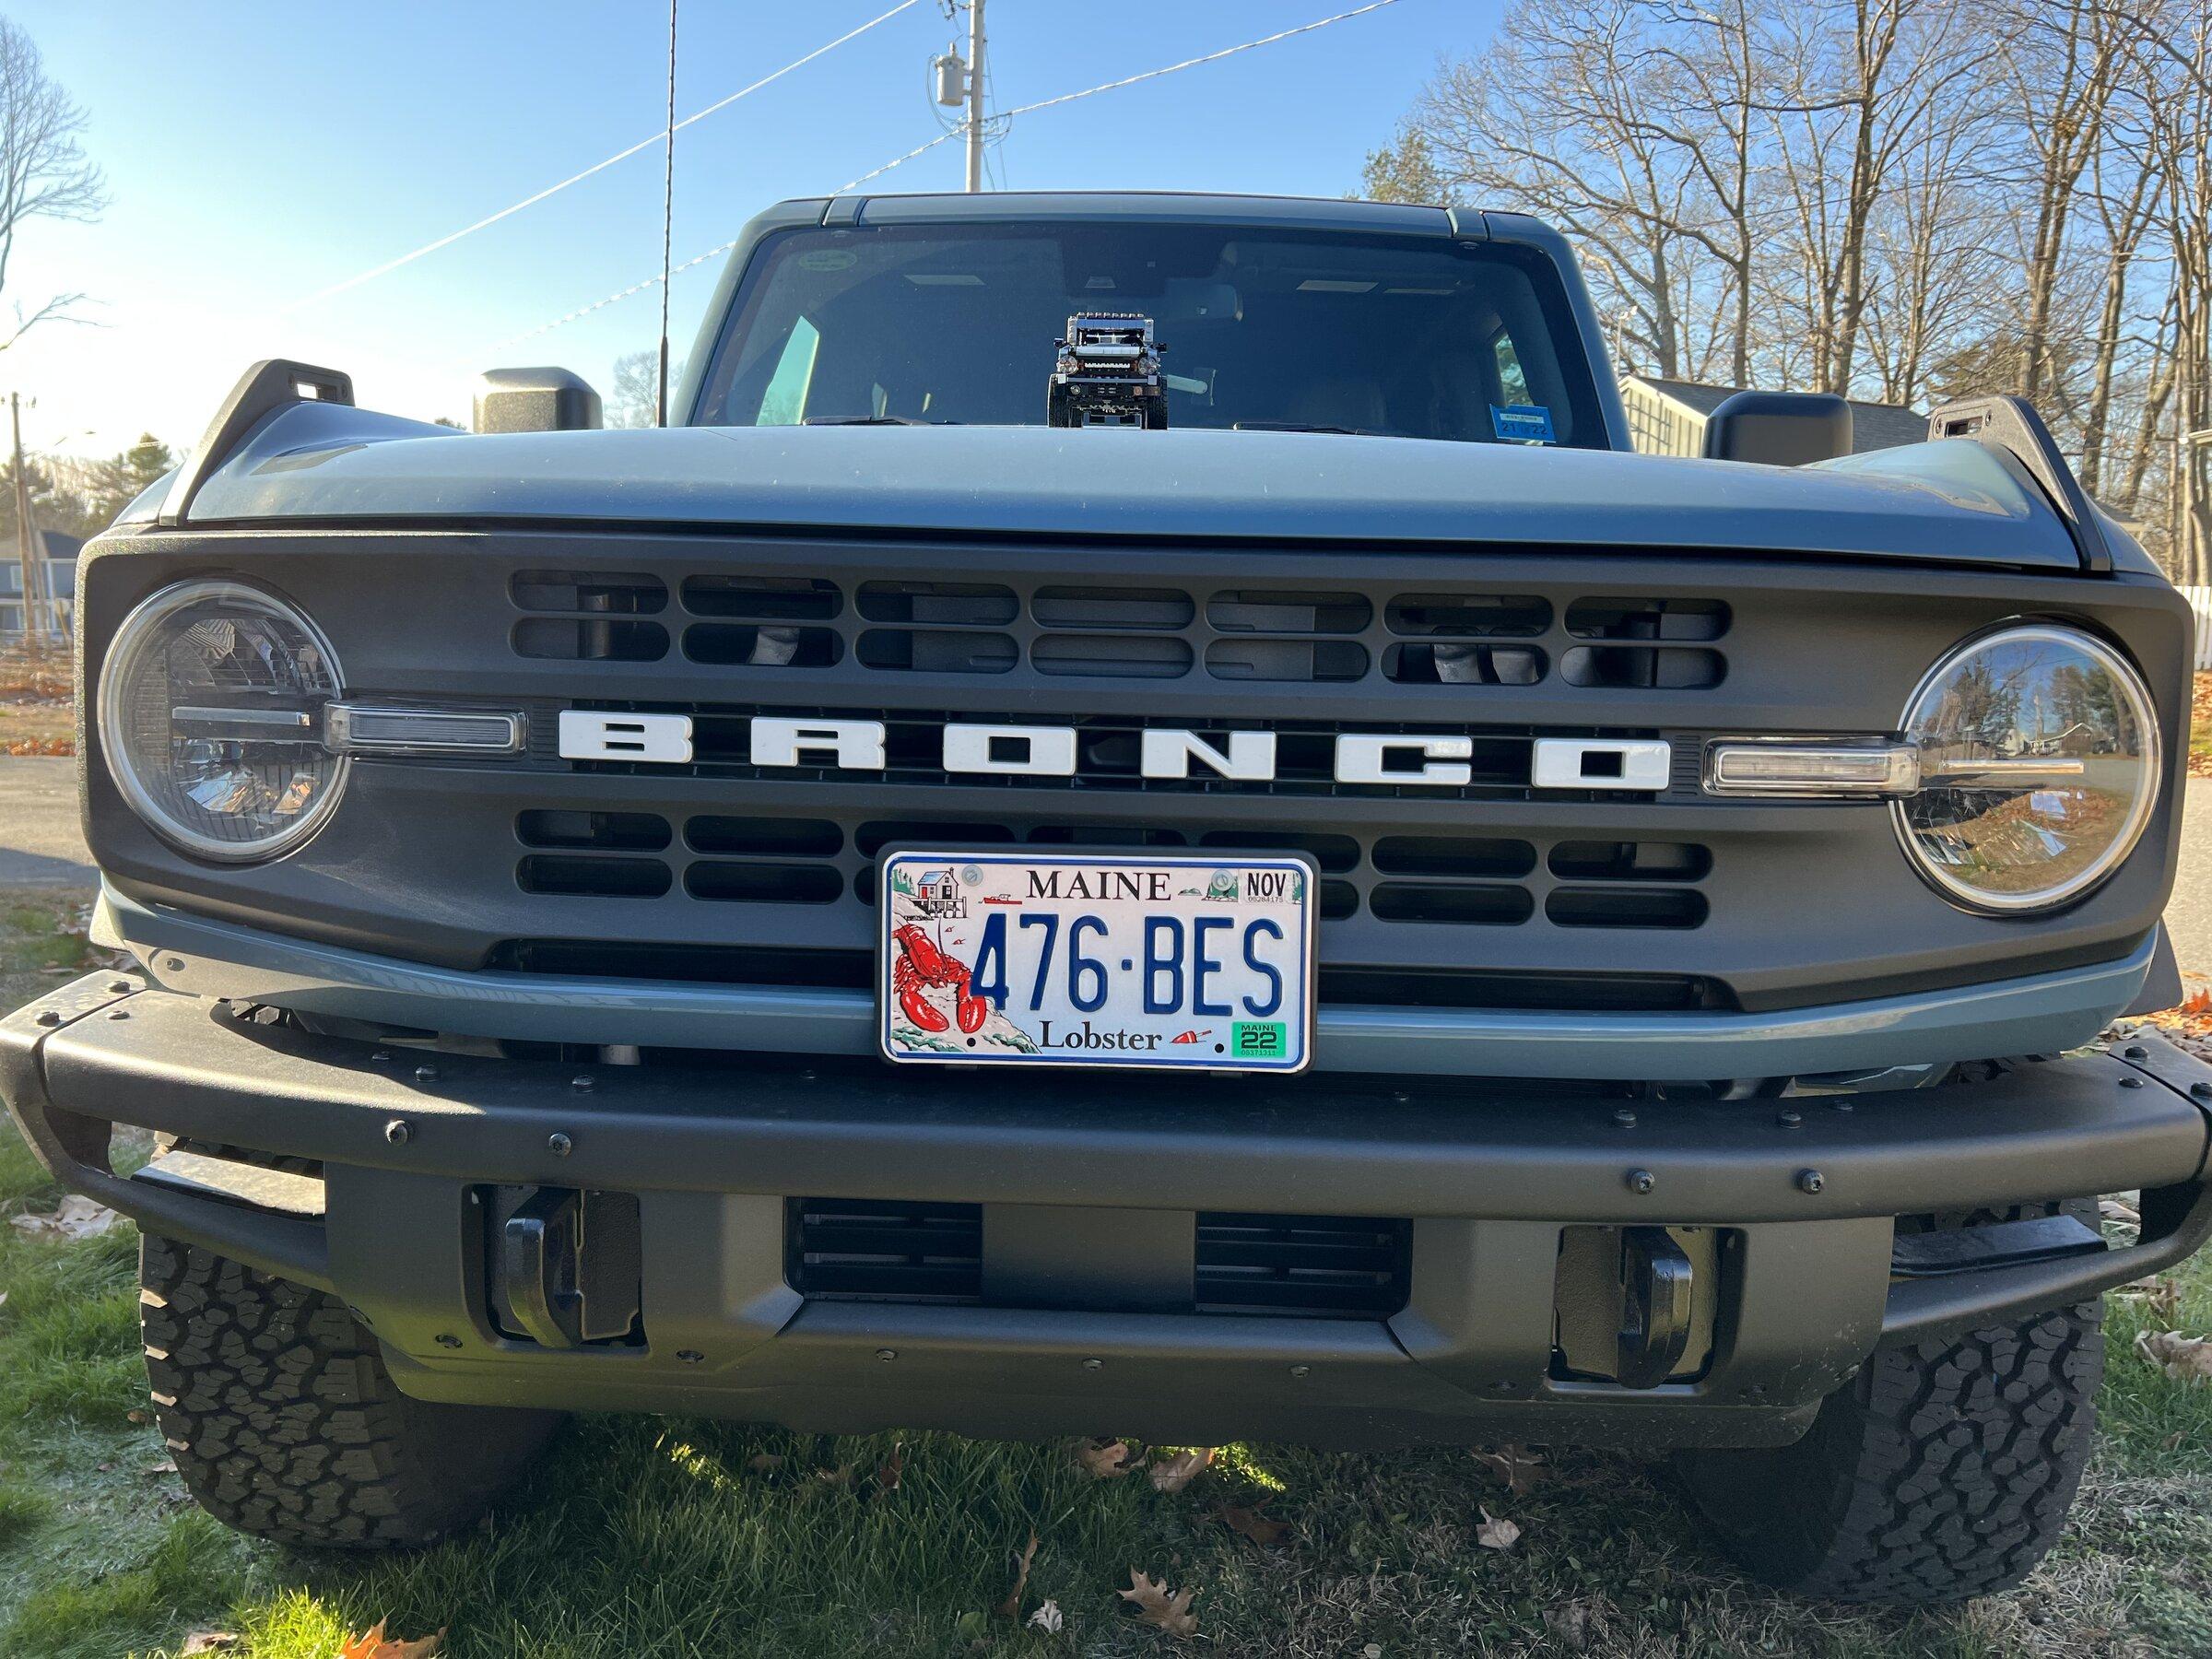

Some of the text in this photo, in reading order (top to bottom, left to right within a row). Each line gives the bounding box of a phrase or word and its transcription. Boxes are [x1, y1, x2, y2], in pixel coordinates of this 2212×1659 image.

[559, 709, 1671, 790] BRONCO
[1026, 870, 1171, 900] MAINE
[1247, 872, 1287, 897] NOV
[1039, 1020, 1163, 1050] Lobster
[1241, 1031, 1277, 1049] 22
